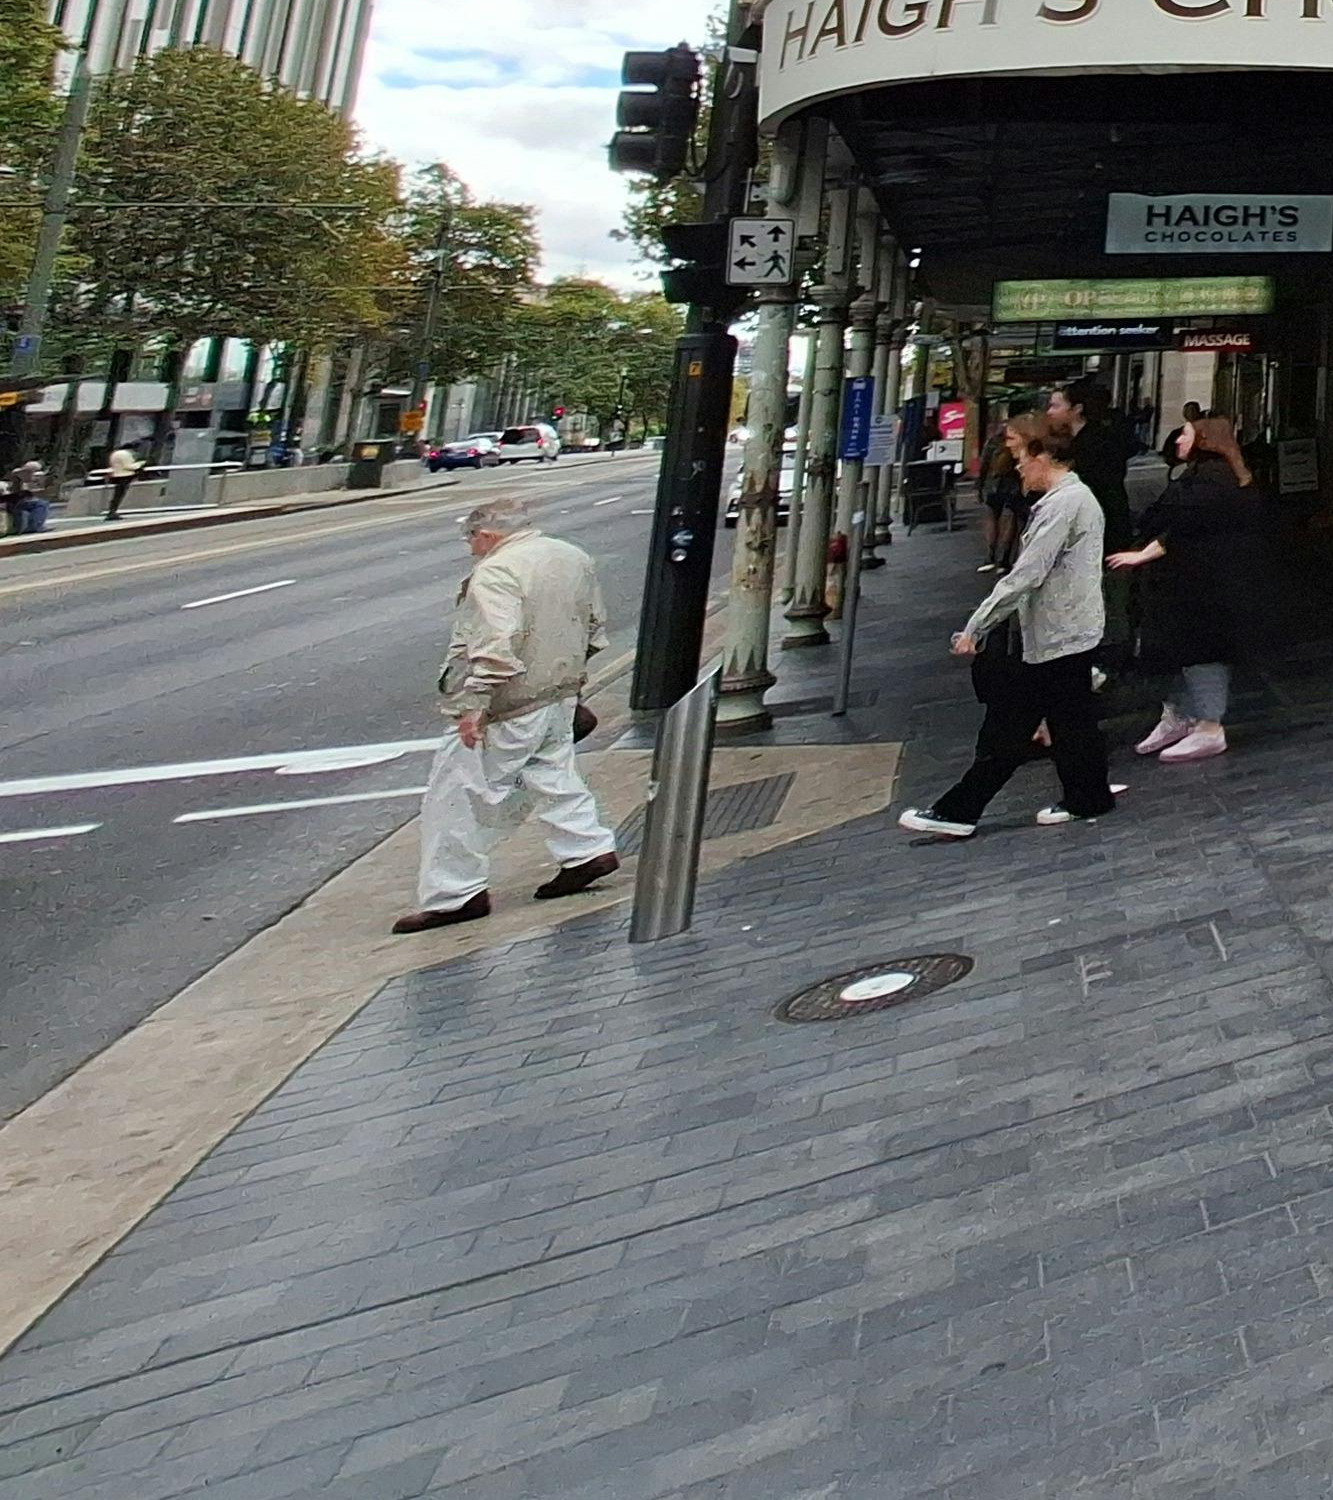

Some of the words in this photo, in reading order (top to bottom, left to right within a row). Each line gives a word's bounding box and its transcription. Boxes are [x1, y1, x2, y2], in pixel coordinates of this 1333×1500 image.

[1146, 205, 1299, 226] HAIGH'S
[1145, 231, 1297, 242] CHOCOLATES
[1184, 333, 1251, 347] MASSAGE
